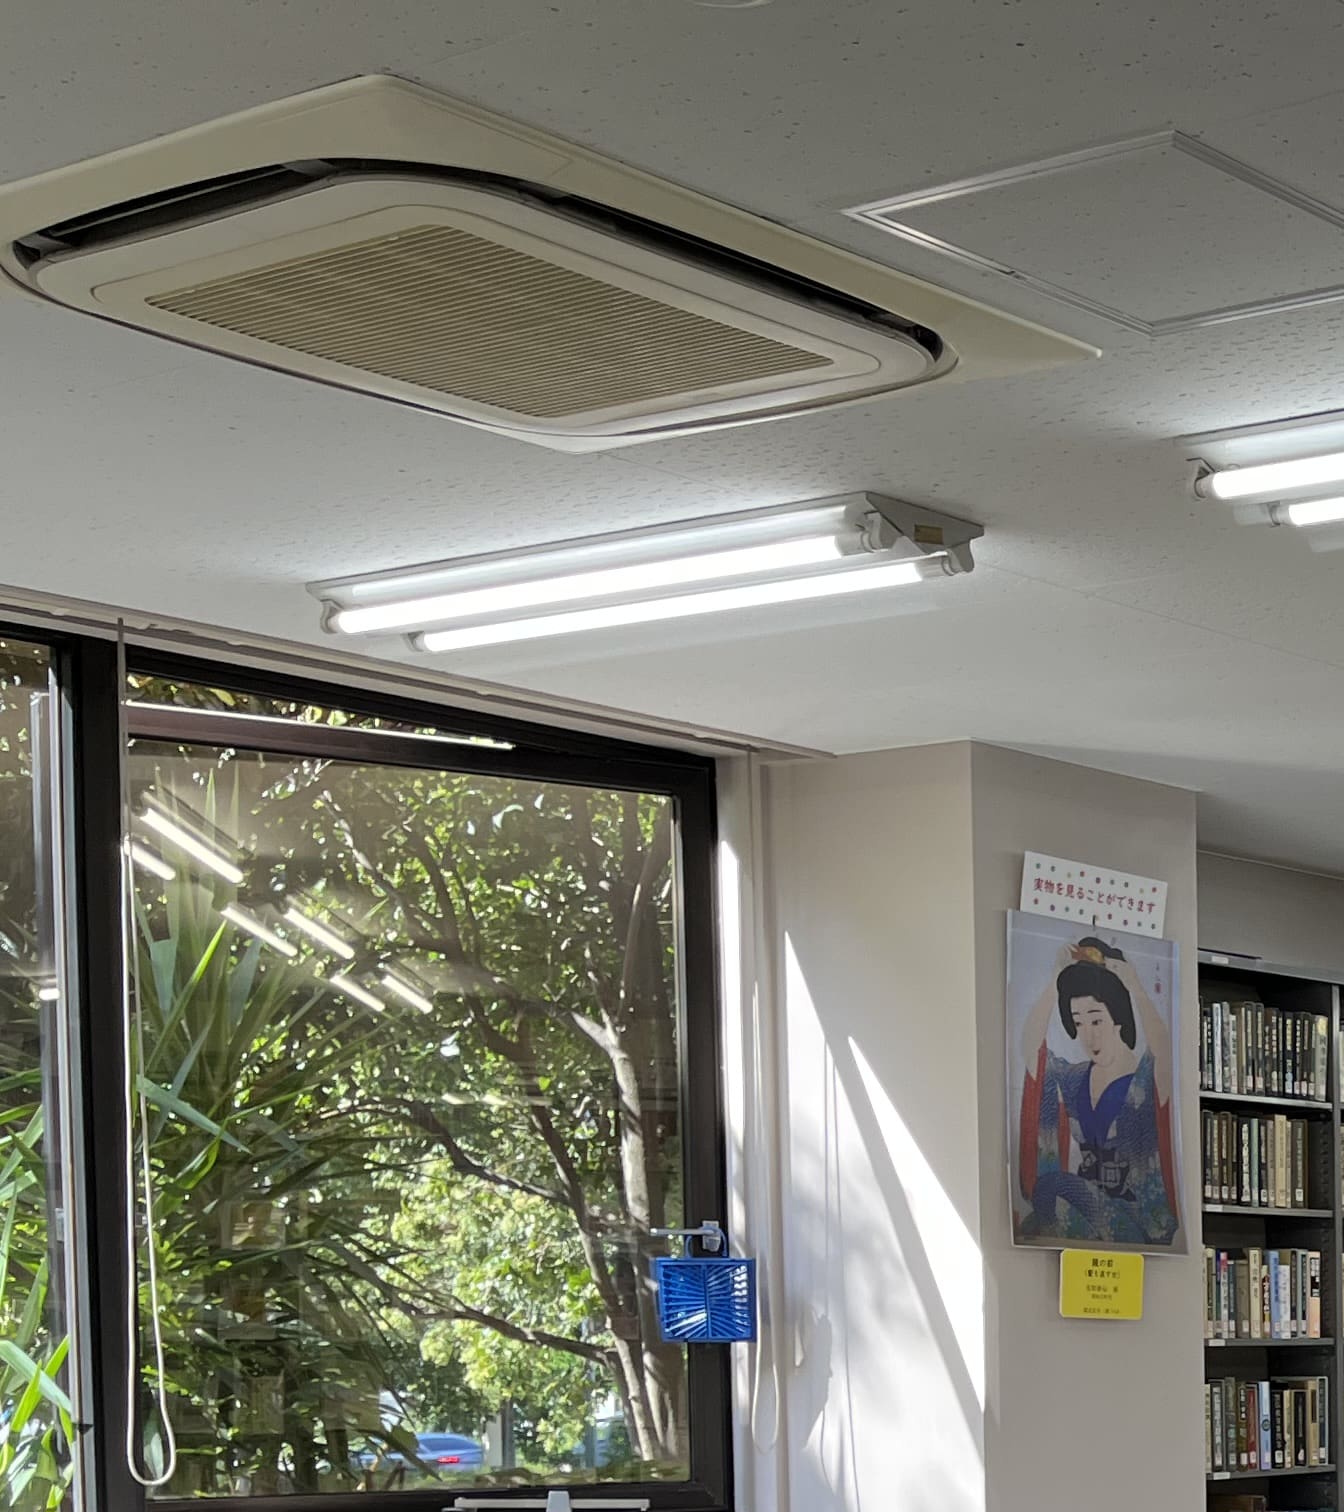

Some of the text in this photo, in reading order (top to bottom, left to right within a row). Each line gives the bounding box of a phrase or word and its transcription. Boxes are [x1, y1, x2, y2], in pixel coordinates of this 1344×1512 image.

[1033, 877, 1156, 914] 実物を見ることができます
